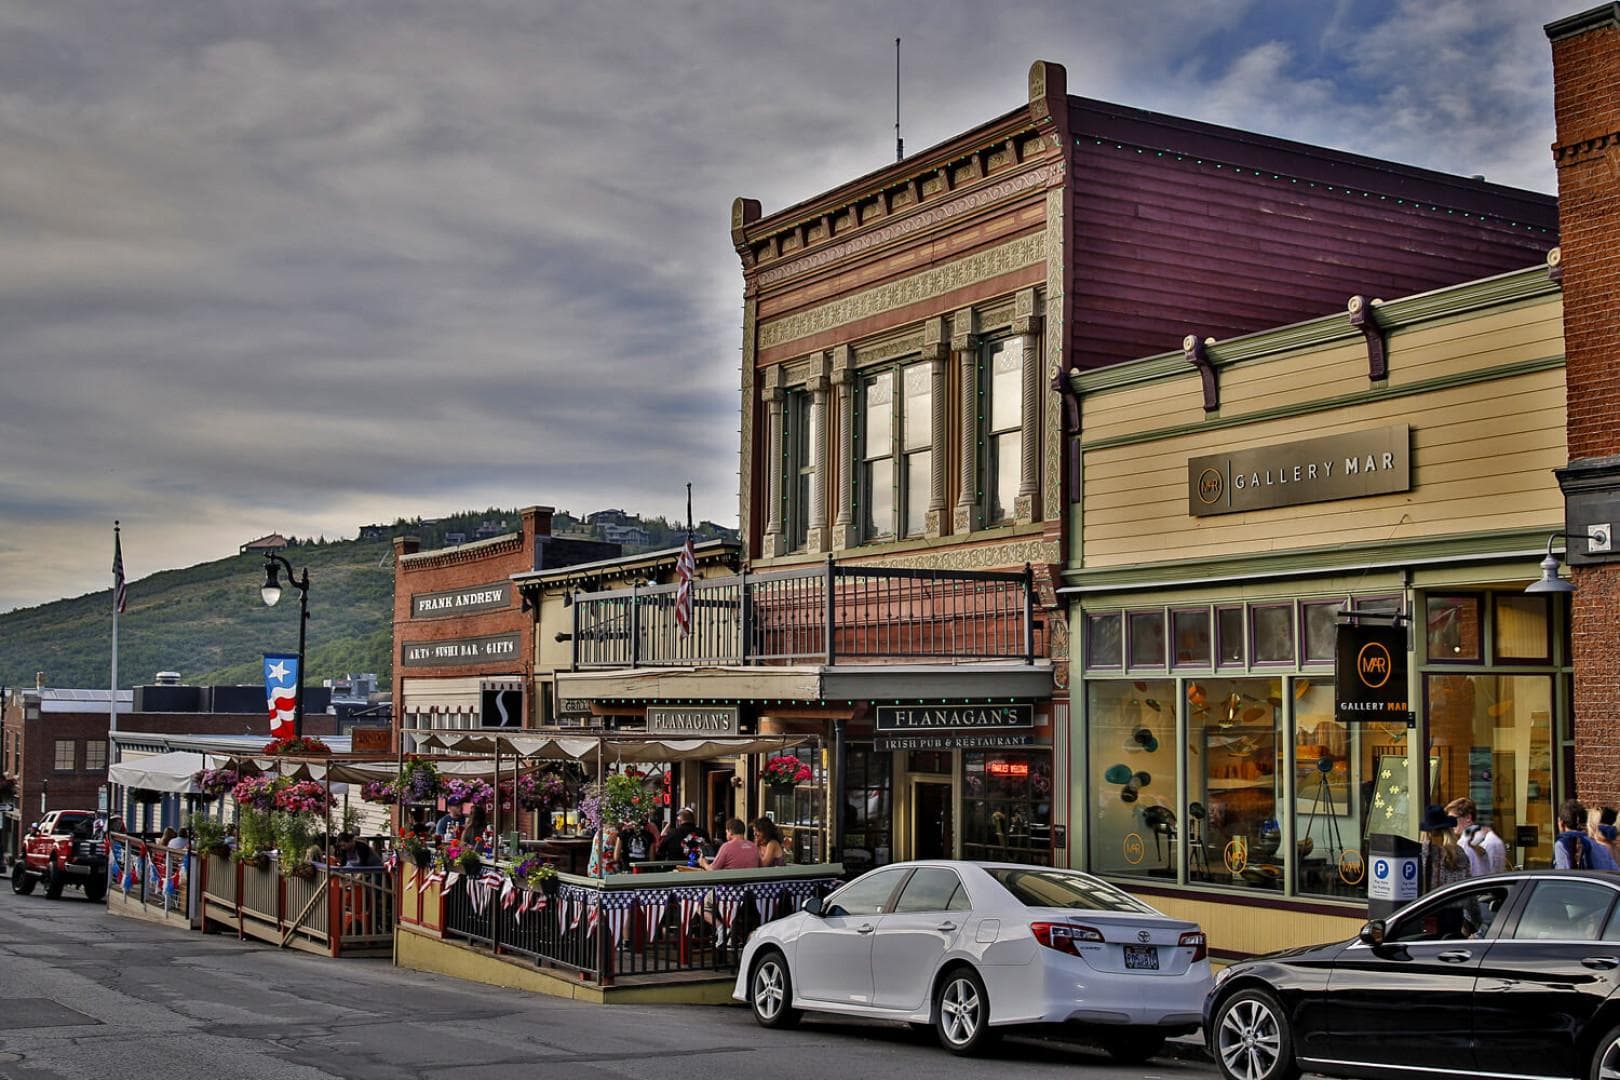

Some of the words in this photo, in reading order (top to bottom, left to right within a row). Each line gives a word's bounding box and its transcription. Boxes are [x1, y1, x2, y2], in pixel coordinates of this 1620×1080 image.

[1235, 462, 1334, 489] GALLERY
[1345, 452, 1394, 474] MAR
[419, 596, 453, 611] FRANK
[455, 590, 503, 607] ANDREW
[409, 648, 430, 660] ARTS
[435, 645, 459, 658] SUSHI
[460, 644, 479, 657] BAR
[486, 641, 514, 655] GIFTS
[1362, 657, 1386, 673] MAR
[1340, 702, 1385, 711] GALLERY
[654, 713, 731, 731] FLANAGAN'S
[895, 709, 1018, 726] FLANAGAN'S
[885, 739, 916, 749] IRISH
[920, 738, 942, 748] PUB
[955, 736, 1027, 748] RESTAURANT
[1377, 863, 1386, 876] P
[1405, 864, 1414, 877] P
